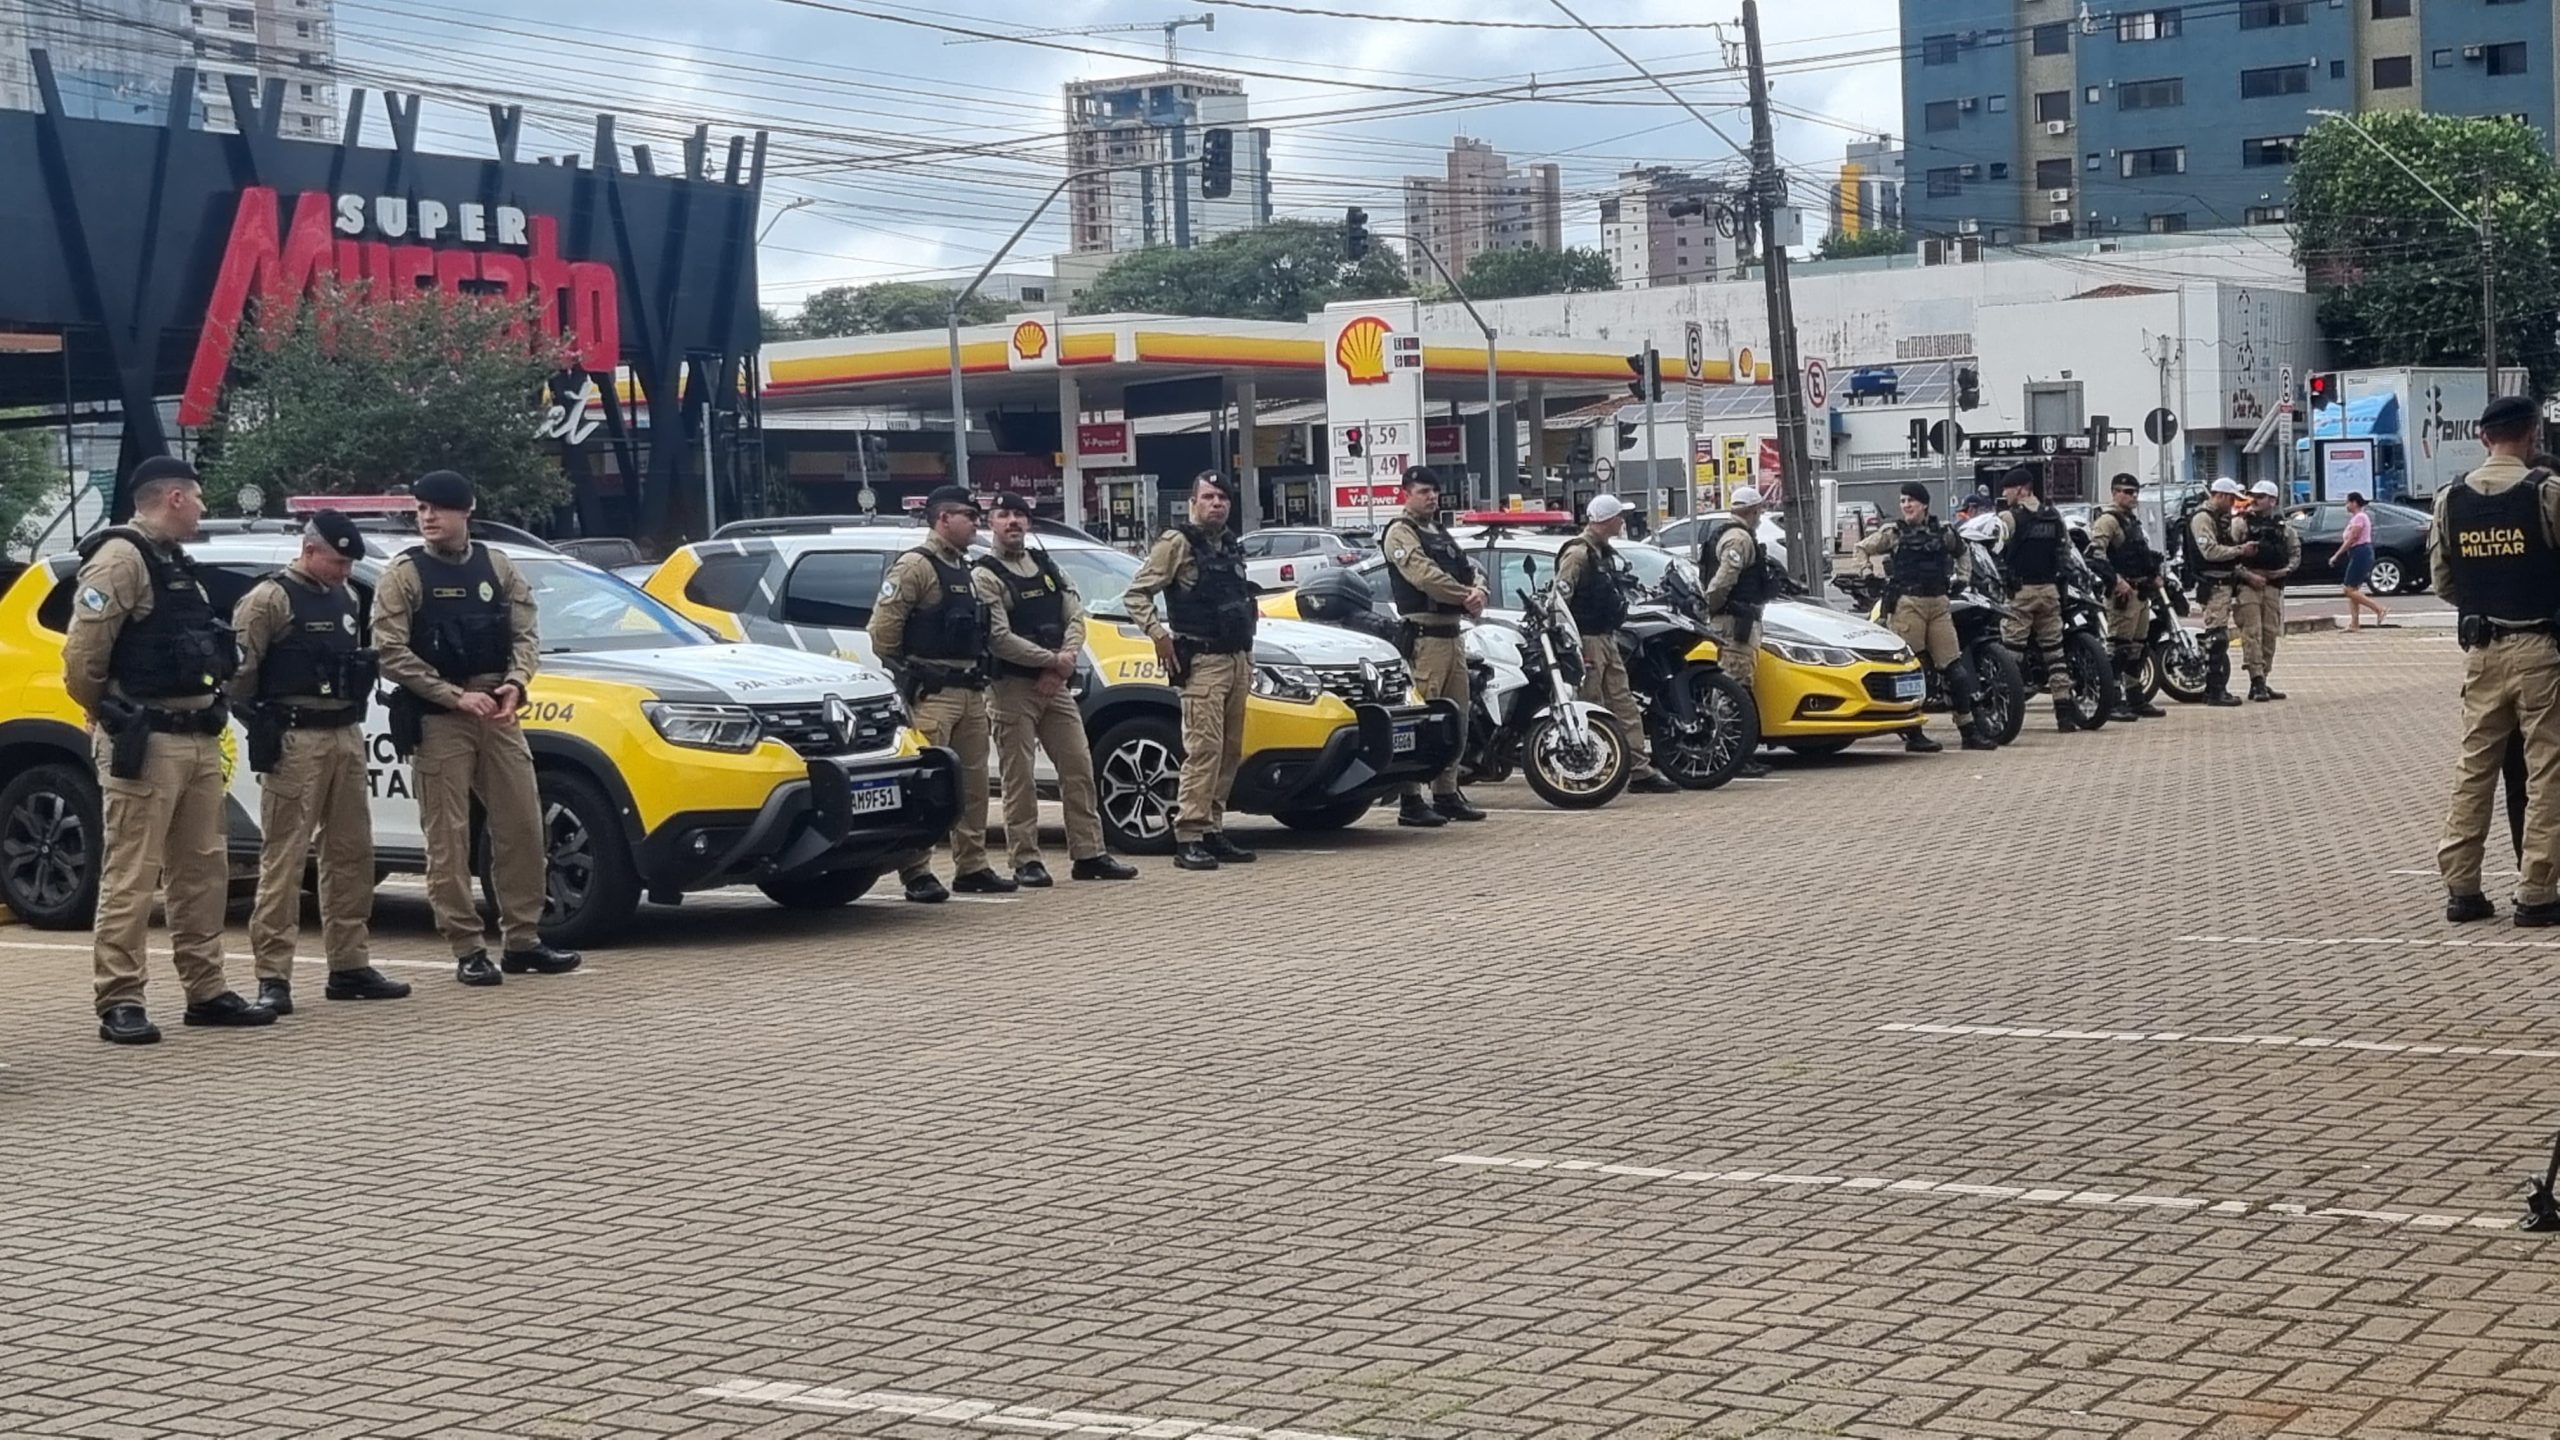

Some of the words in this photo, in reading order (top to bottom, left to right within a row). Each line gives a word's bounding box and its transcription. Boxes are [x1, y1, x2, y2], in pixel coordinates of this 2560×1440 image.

[335, 193, 529, 246] SUPER
[1348, 494, 1398, 506] V-Power
[2459, 527, 2525, 544] POLÍCIA
[2461, 542, 2525, 558] MILITAR
